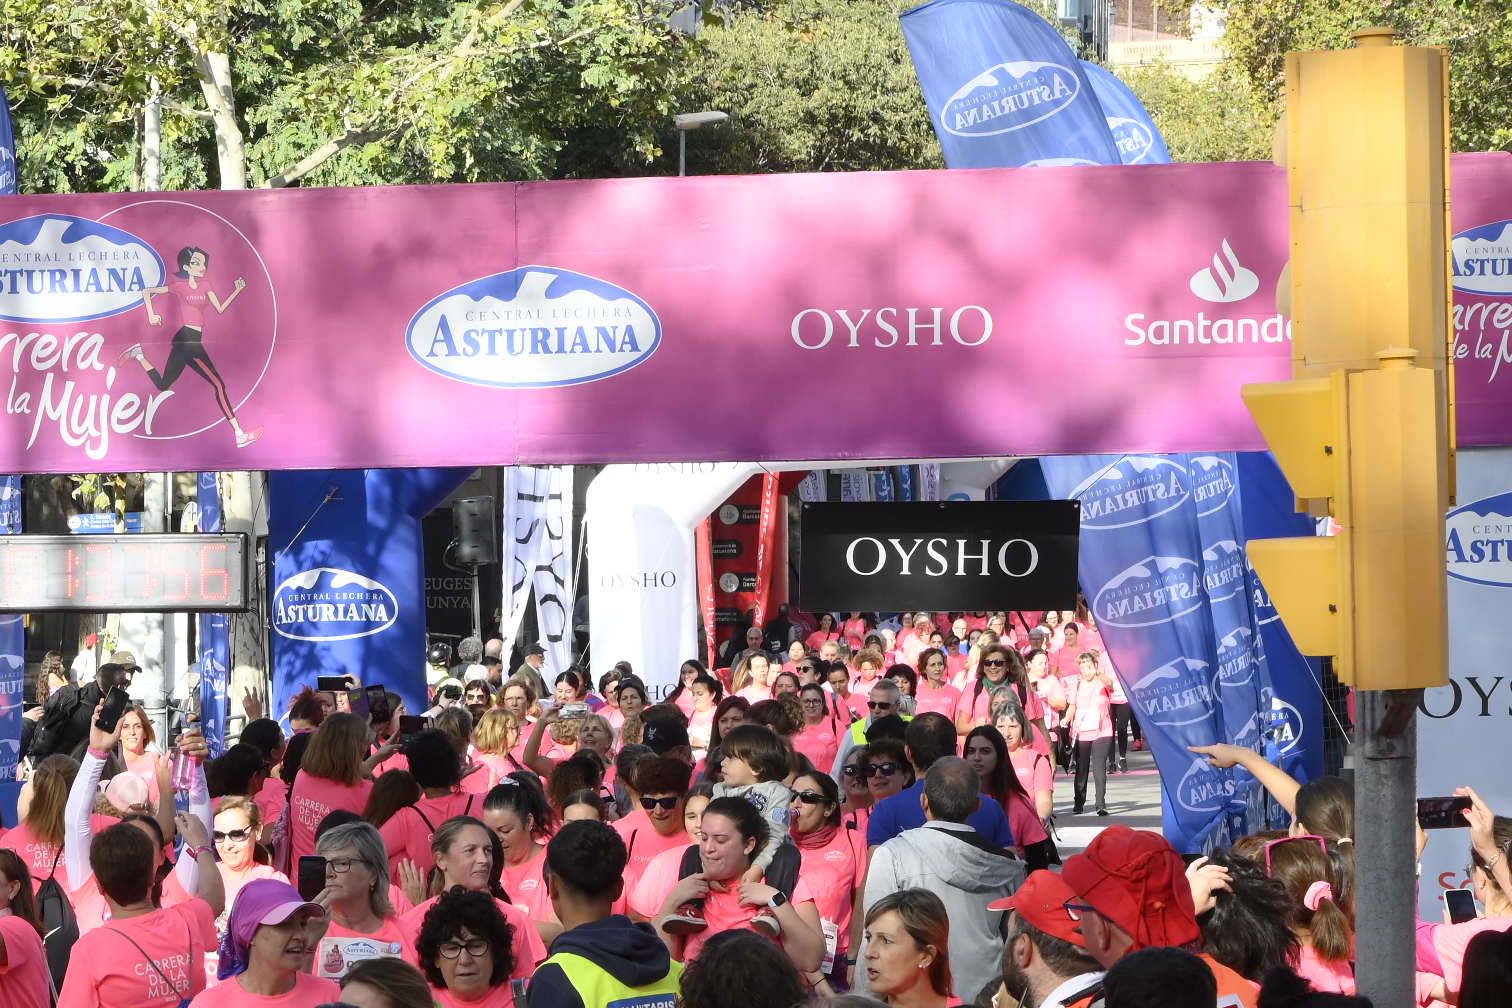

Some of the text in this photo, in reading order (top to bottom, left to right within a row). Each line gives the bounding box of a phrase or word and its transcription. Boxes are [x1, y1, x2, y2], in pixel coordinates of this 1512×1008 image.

[67, 249, 141, 262] LECHERA
[464, 307, 546, 322] CENTRAL
[789, 305, 994, 352] OYSHO
[1123, 311, 1292, 346] Santand
[425, 312, 642, 359] ASTURIANA
[6, 373, 33, 415] la
[25, 367, 177, 460] Mujer
[845, 537, 1040, 578] OYSHO
[600, 570, 677, 588] OYSHO
[288, 591, 384, 602] CENTRAL LECHERA
[275, 597, 389, 625] ASTURIANA
[169, 967, 187, 981] LA
